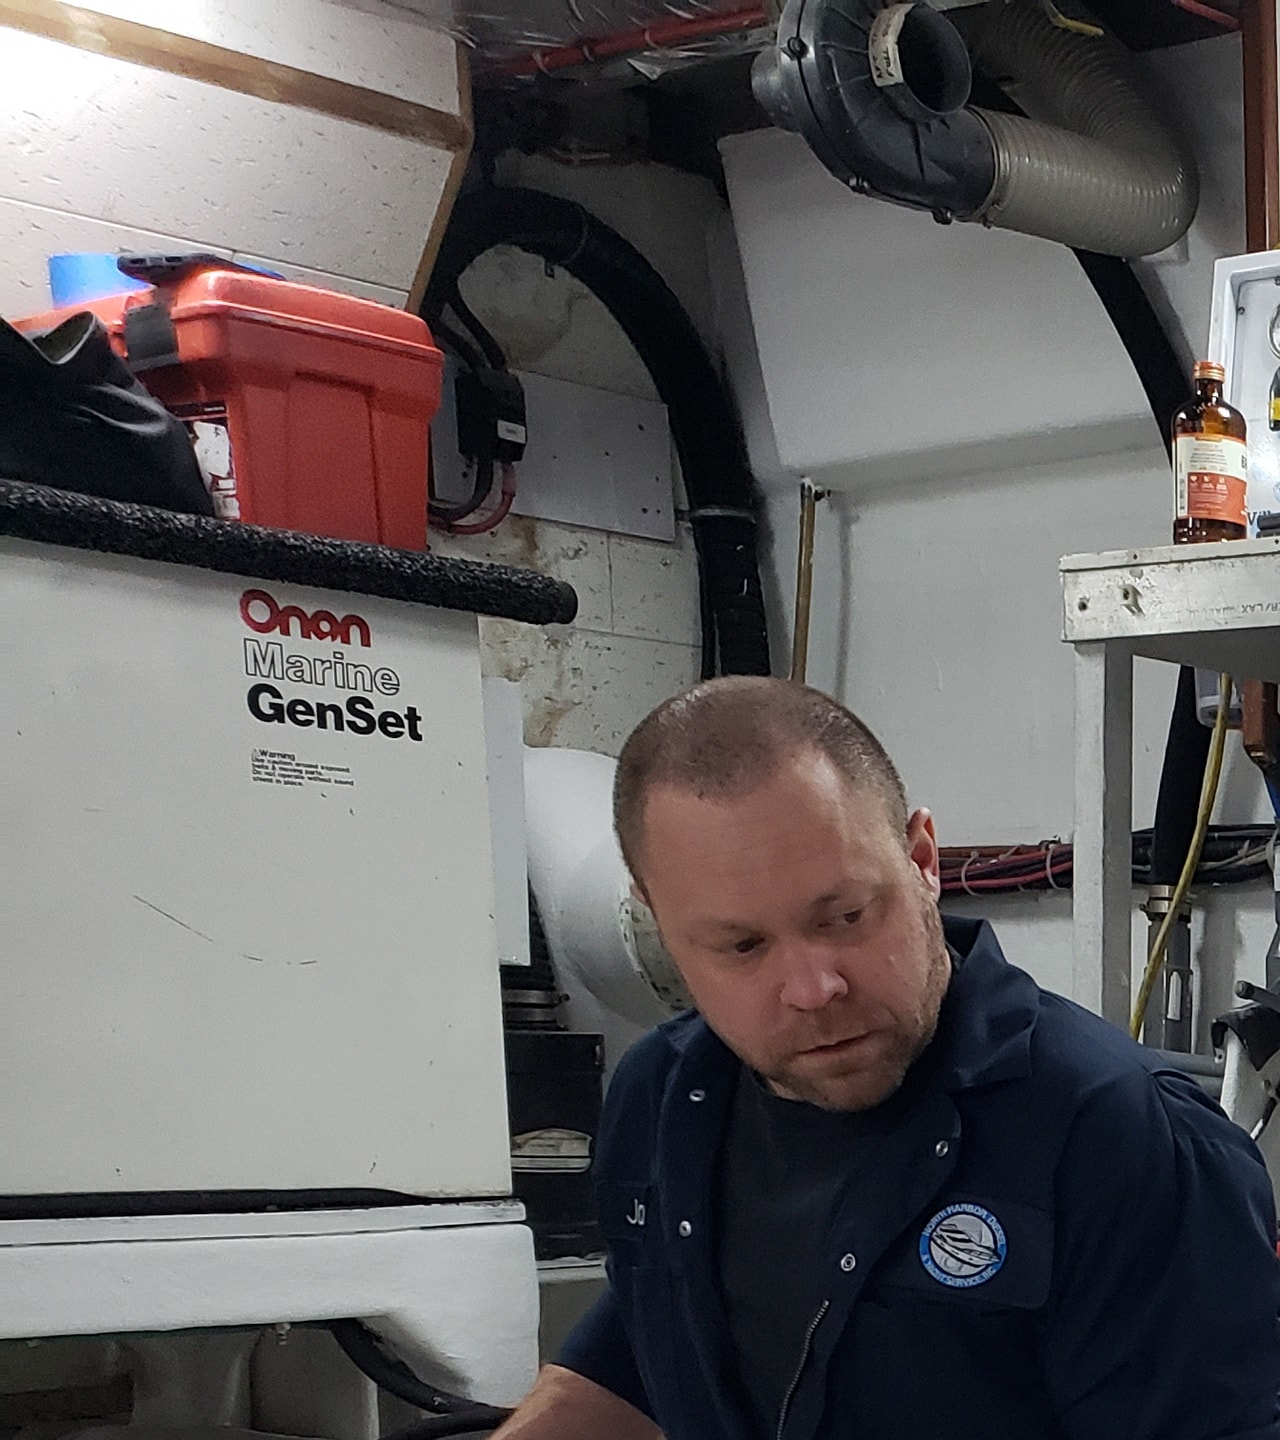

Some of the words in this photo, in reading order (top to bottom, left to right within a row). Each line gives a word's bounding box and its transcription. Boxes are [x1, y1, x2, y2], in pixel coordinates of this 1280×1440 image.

[244, 638, 400, 695] Marine
[247, 683, 423, 741] GenSet
[259, 749, 295, 761] Warning
